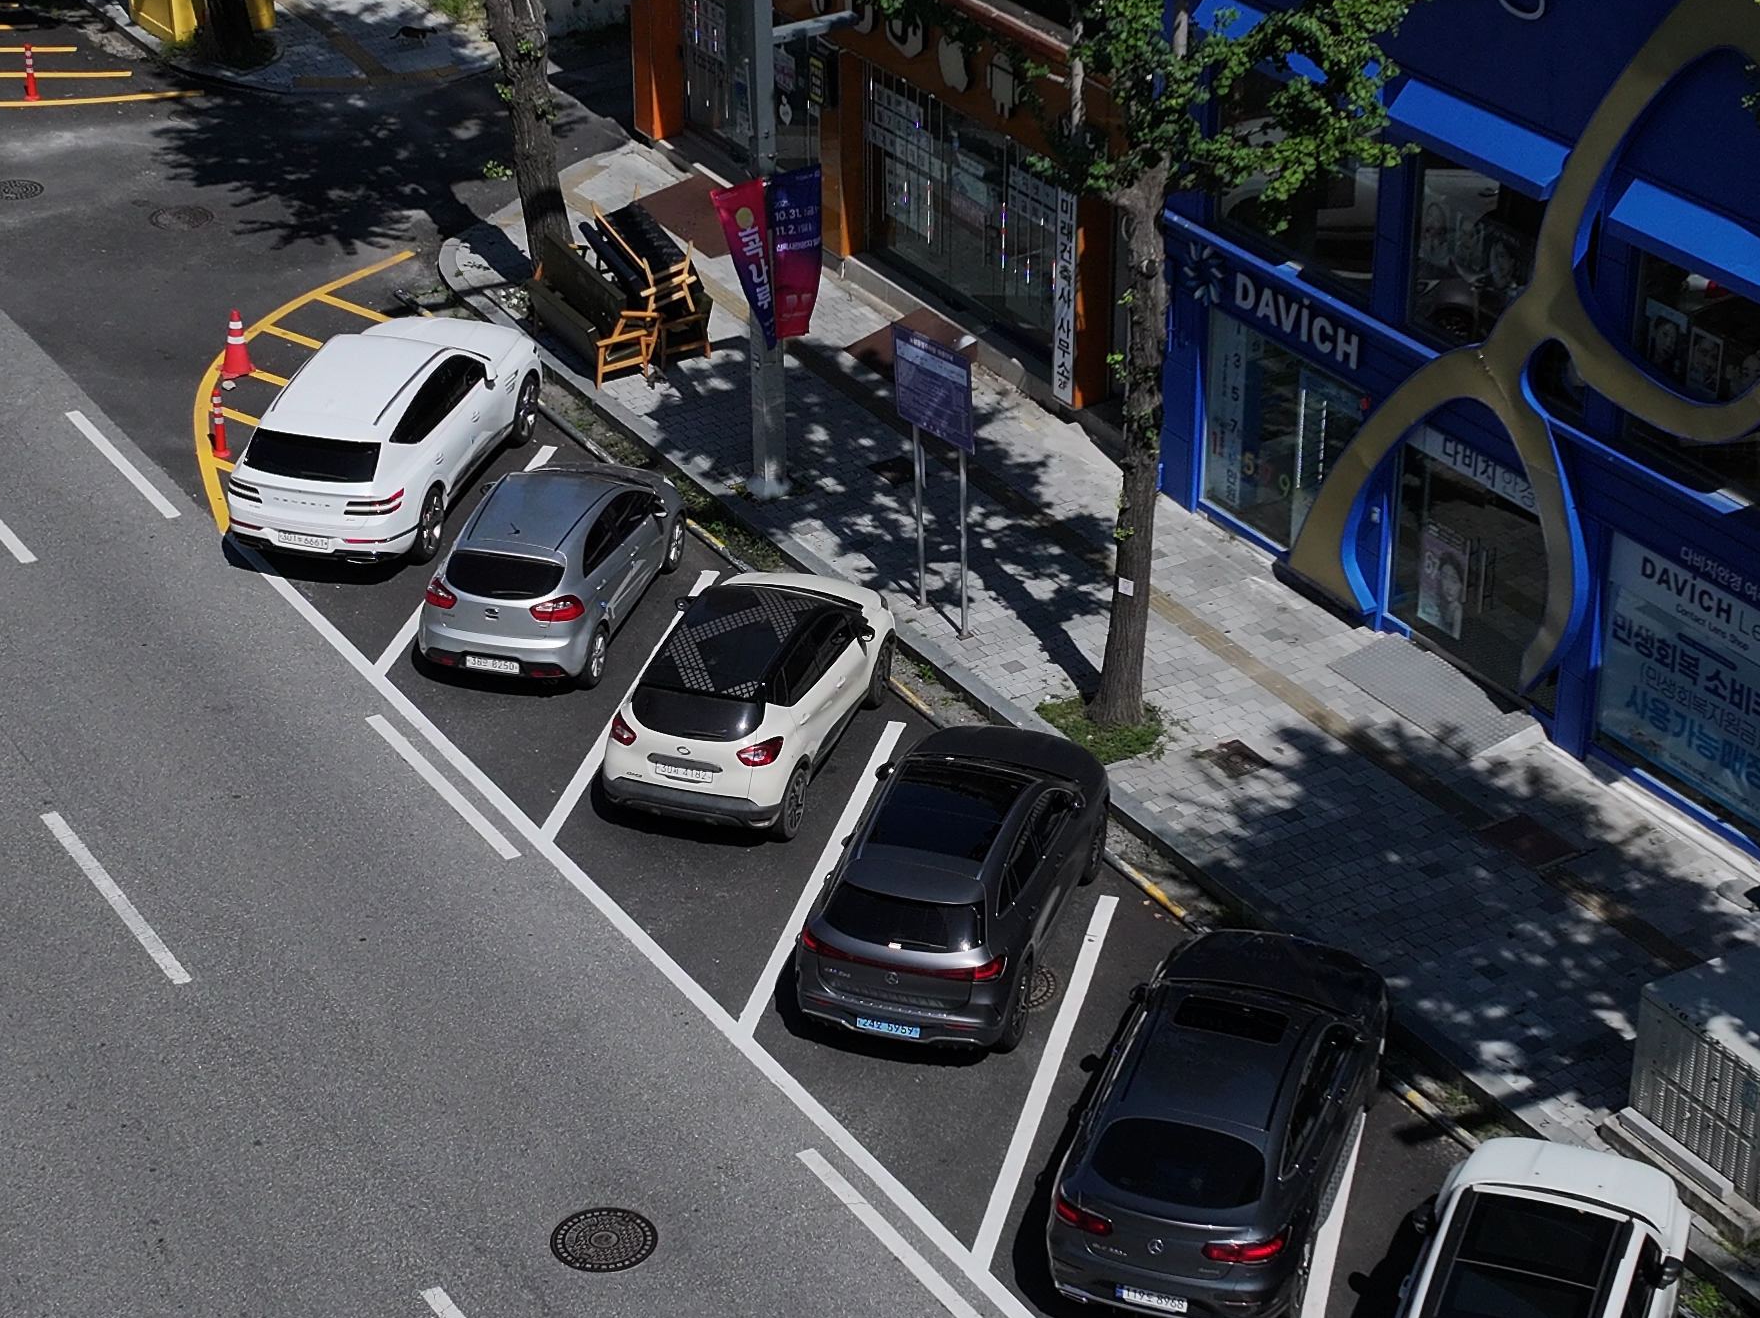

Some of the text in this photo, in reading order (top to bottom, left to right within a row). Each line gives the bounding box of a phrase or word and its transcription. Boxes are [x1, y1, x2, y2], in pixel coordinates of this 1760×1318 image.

[1056, 318, 1072, 381] 사무소
[1680, 546, 1743, 591] 다비치안경
[1611, 613, 1701, 682] 민생회복
